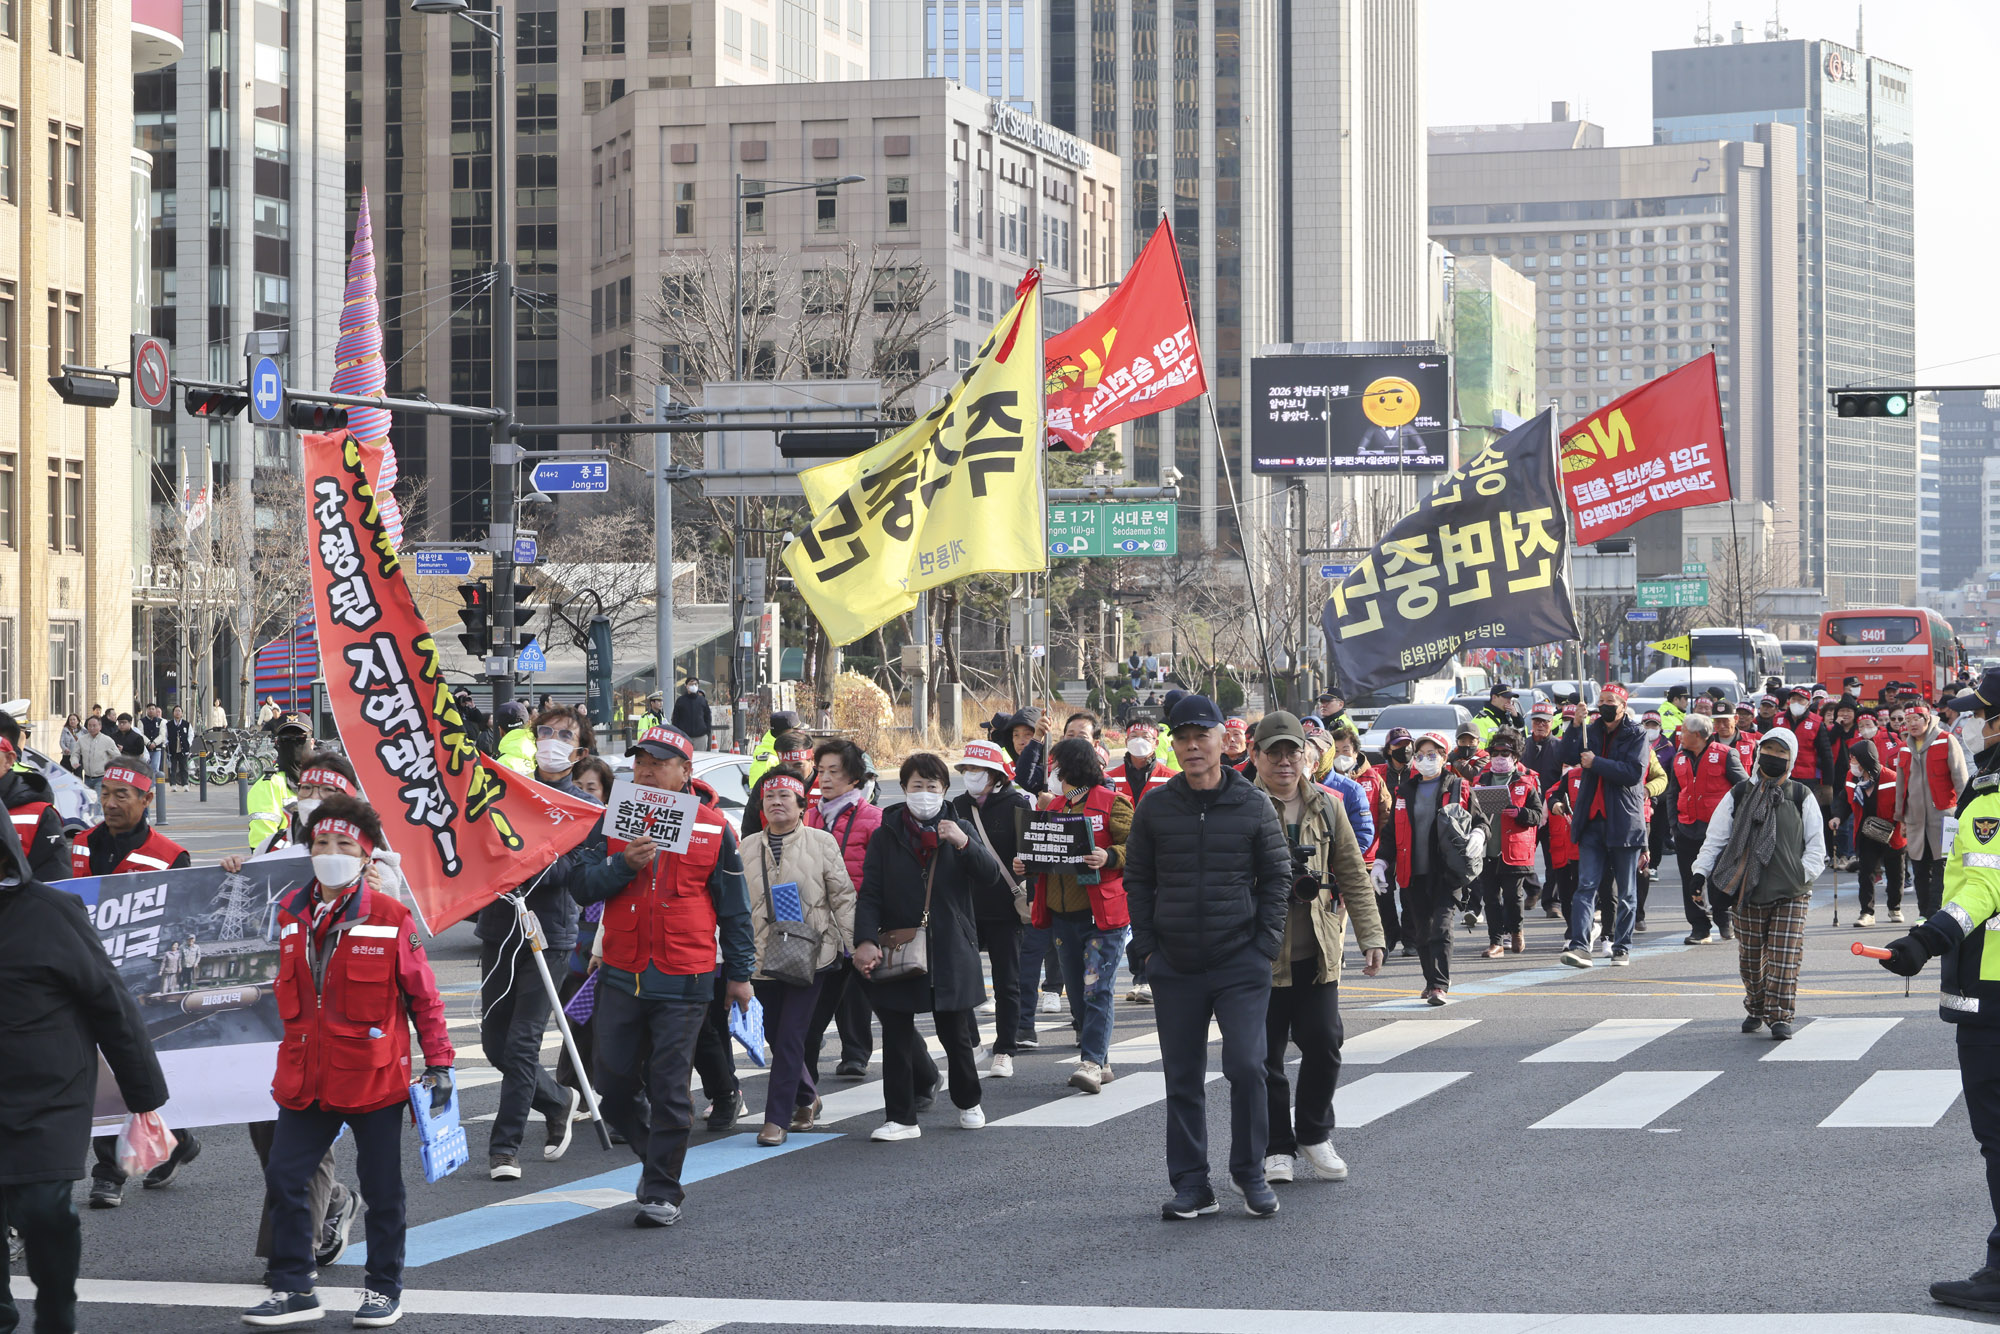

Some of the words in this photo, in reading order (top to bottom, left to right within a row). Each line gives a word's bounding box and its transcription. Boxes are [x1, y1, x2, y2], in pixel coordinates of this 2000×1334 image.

[1009, 111, 1036, 145] SEOUL
[1035, 123, 1069, 159] FINANCE
[1268, 386, 1291, 397] 2026
[1269, 411, 1279, 421] 더
[580, 465, 604, 480] 종로
[571, 480, 604, 490] Jong-ro
[1111, 510, 1169, 526] 서대문역
[1049, 526, 1068, 537] ngno
[1112, 526, 1152, 536] Seodaemun
[1153, 525, 1166, 535] Stn
[1056, 543, 1064, 553] 6
[1126, 541, 1134, 550] 6
[418, 553, 444, 562] 새문안로
[1862, 629, 1886, 641] 9401
[1871, 646, 1904, 654] LGE.COM
[1708, 752, 1719, 764] 쟁
[642, 791, 669, 804] 345kV
[1061, 855, 1085, 865] 구성하
[351, 945, 385, 955] 송전선로
[201, 990, 242, 1007] 피해지역
